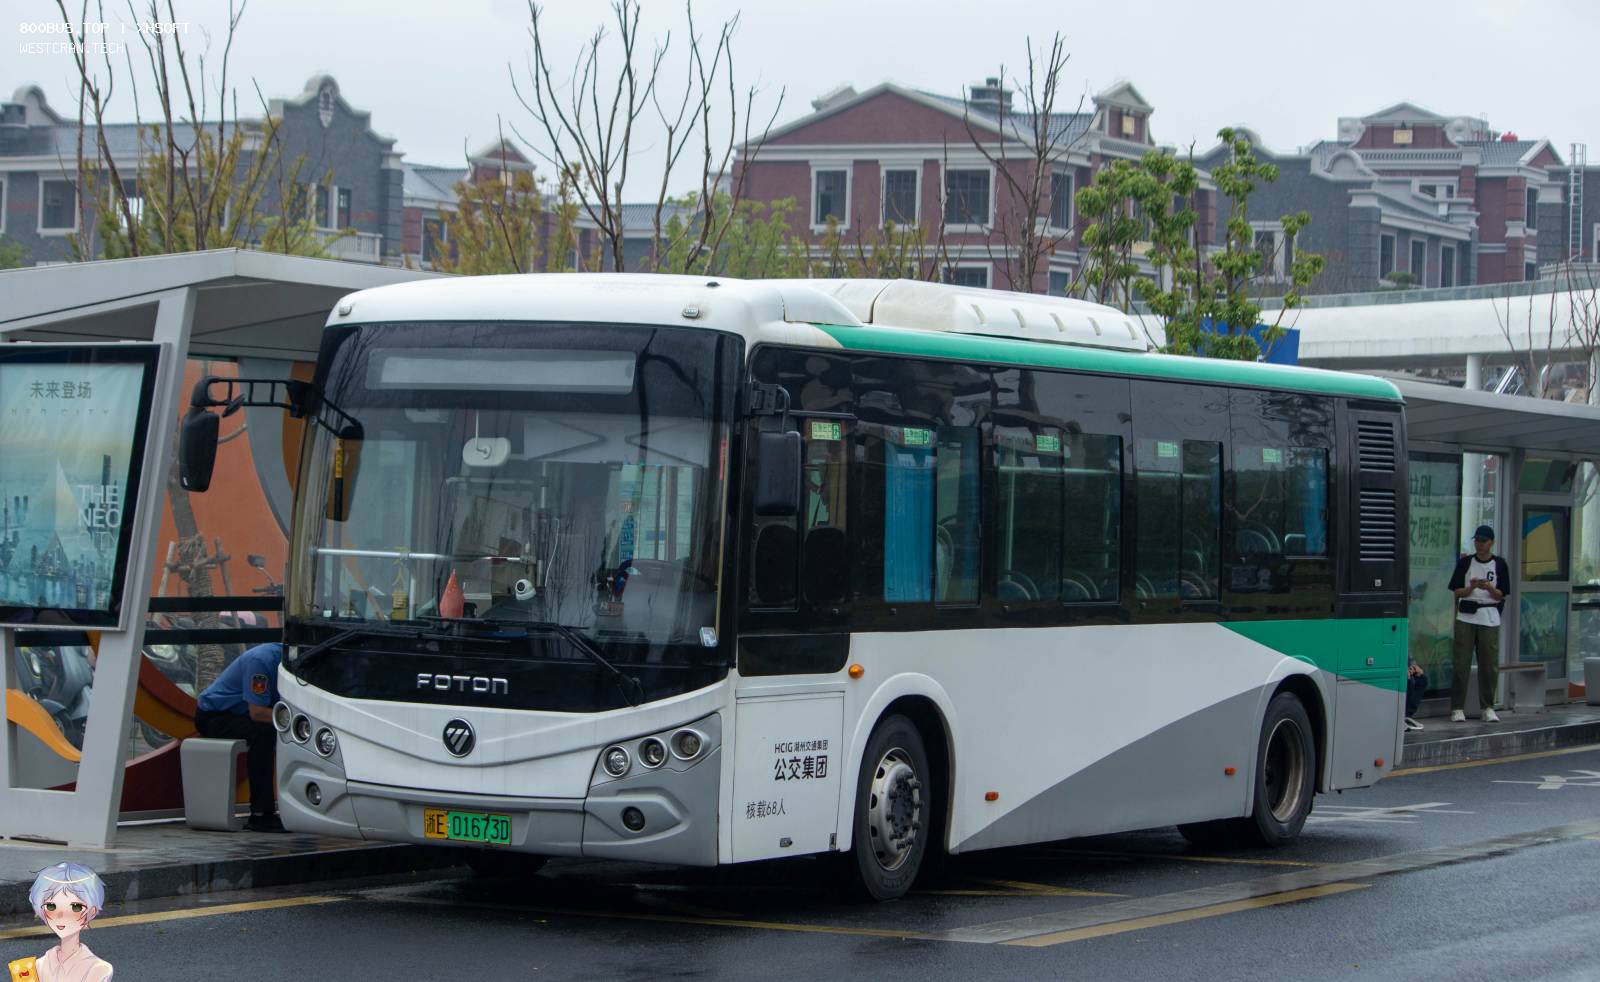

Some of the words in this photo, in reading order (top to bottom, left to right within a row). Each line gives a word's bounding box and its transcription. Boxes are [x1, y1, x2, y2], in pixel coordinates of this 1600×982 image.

[30, 381, 91, 399] 未来登场
[77, 485, 119, 504] THE
[78, 508, 121, 528] NEO
[1486, 571, 1495, 581] G
[416, 673, 509, 694] FOTON
[774, 742, 793, 754] HCIG
[774, 755, 828, 781] 公交集团
[746, 798, 786, 819] 核载68人
